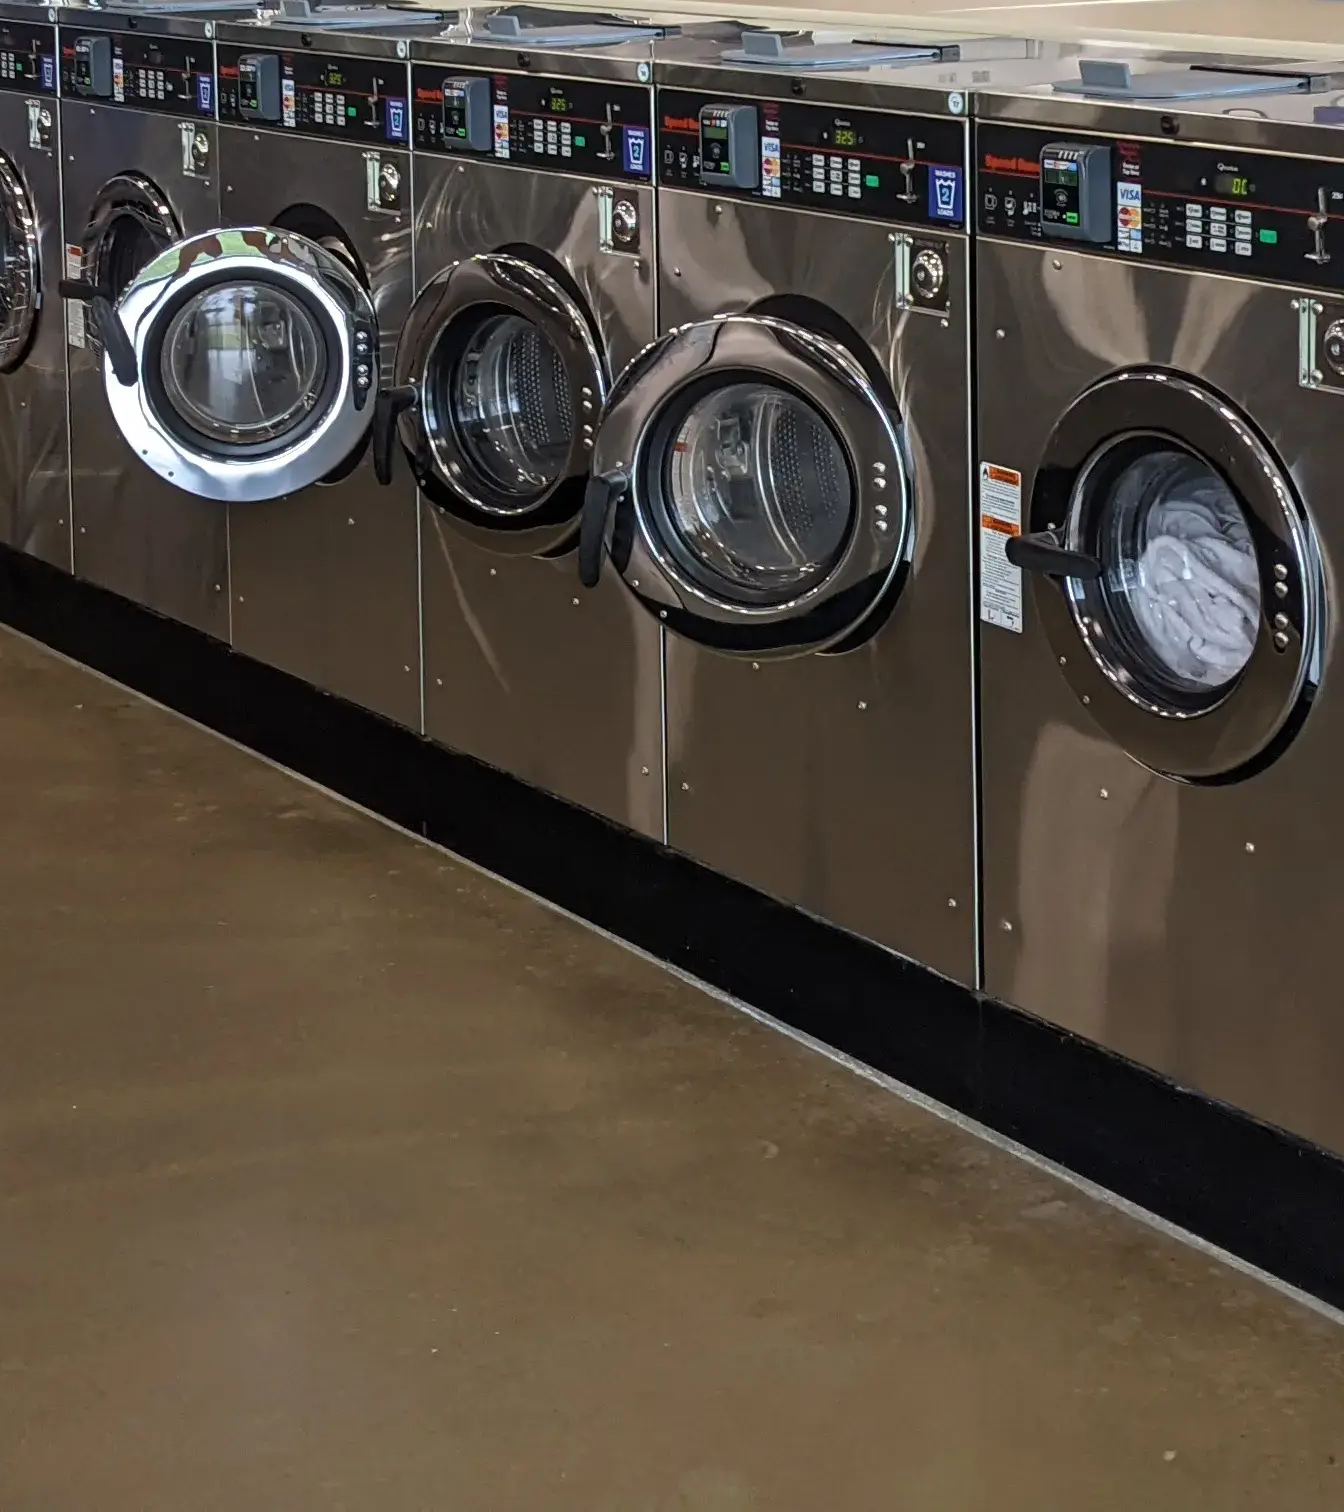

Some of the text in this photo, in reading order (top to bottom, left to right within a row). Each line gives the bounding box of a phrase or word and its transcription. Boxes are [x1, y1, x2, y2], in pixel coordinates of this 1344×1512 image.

[835, 129, 854, 145] 325
[941, 187, 950, 203] 2
[1120, 188, 1141, 201] VISA
